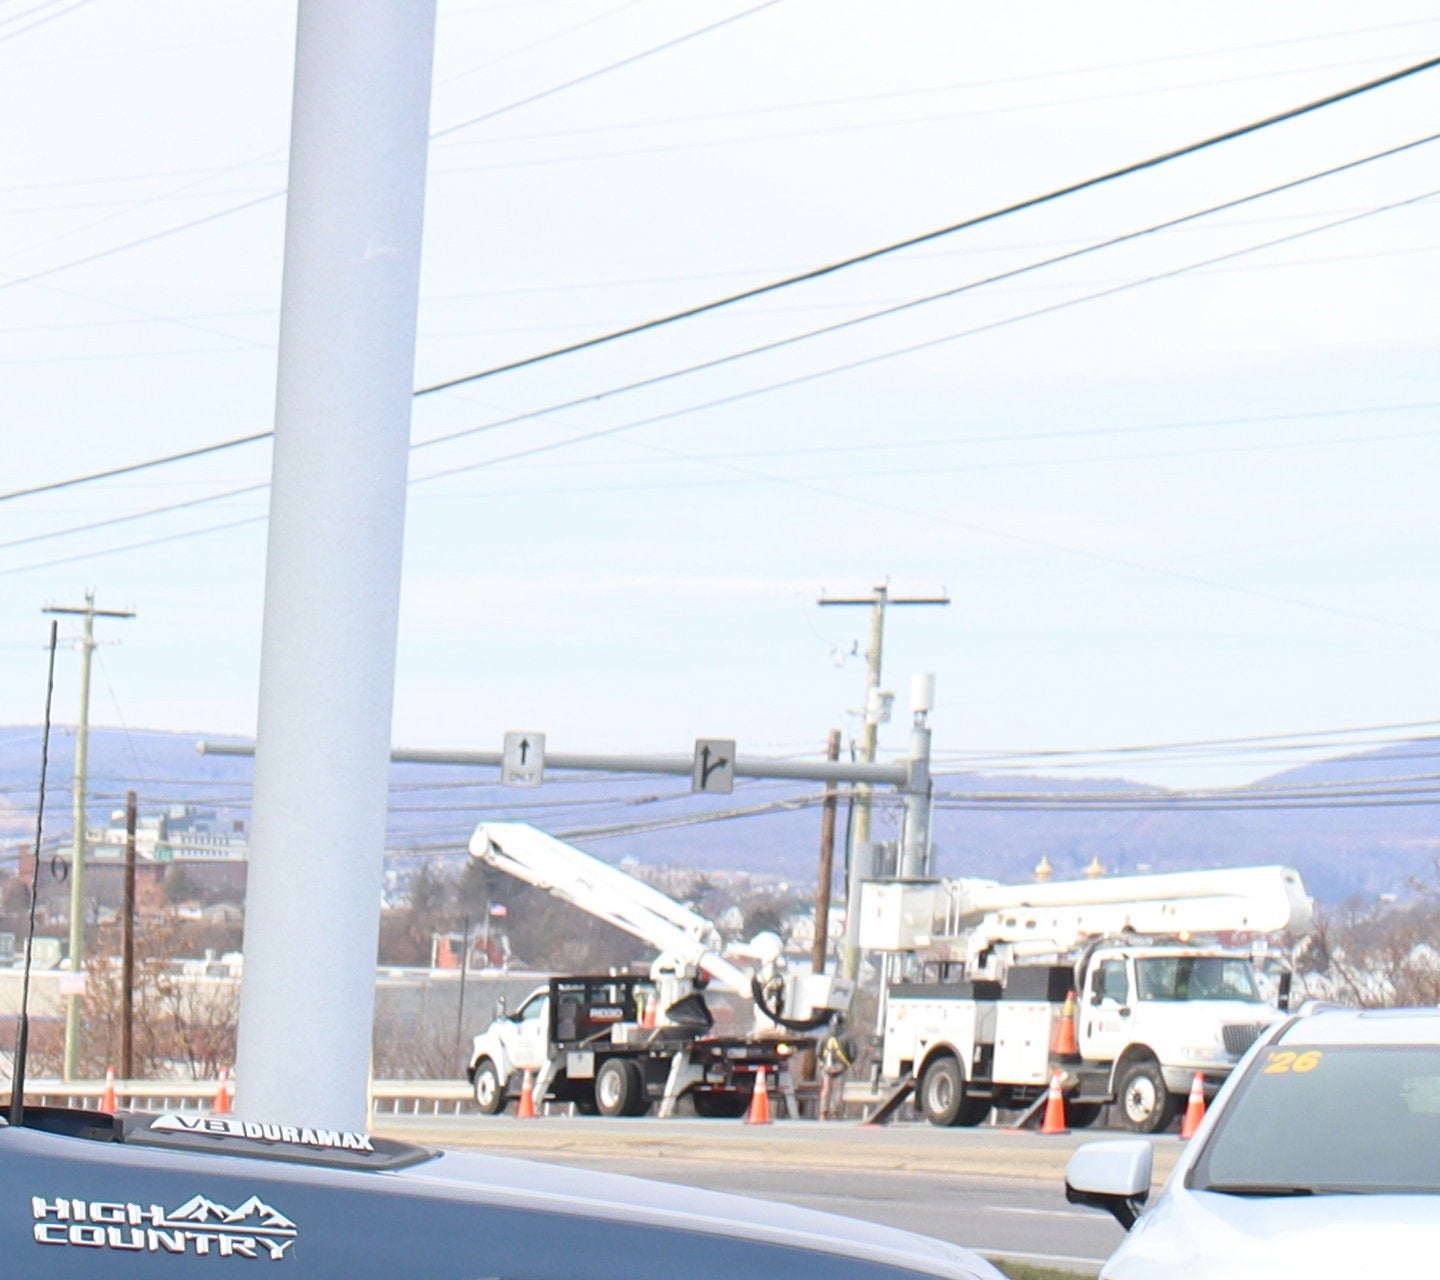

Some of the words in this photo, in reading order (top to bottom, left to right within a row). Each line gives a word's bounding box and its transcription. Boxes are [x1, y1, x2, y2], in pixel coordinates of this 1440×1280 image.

[175, 1115, 231, 1133] V8
[243, 1121, 375, 1151] DURAMAX
[32, 1196, 167, 1227] HIGH
[33, 1223, 295, 1260] COUNTRY
